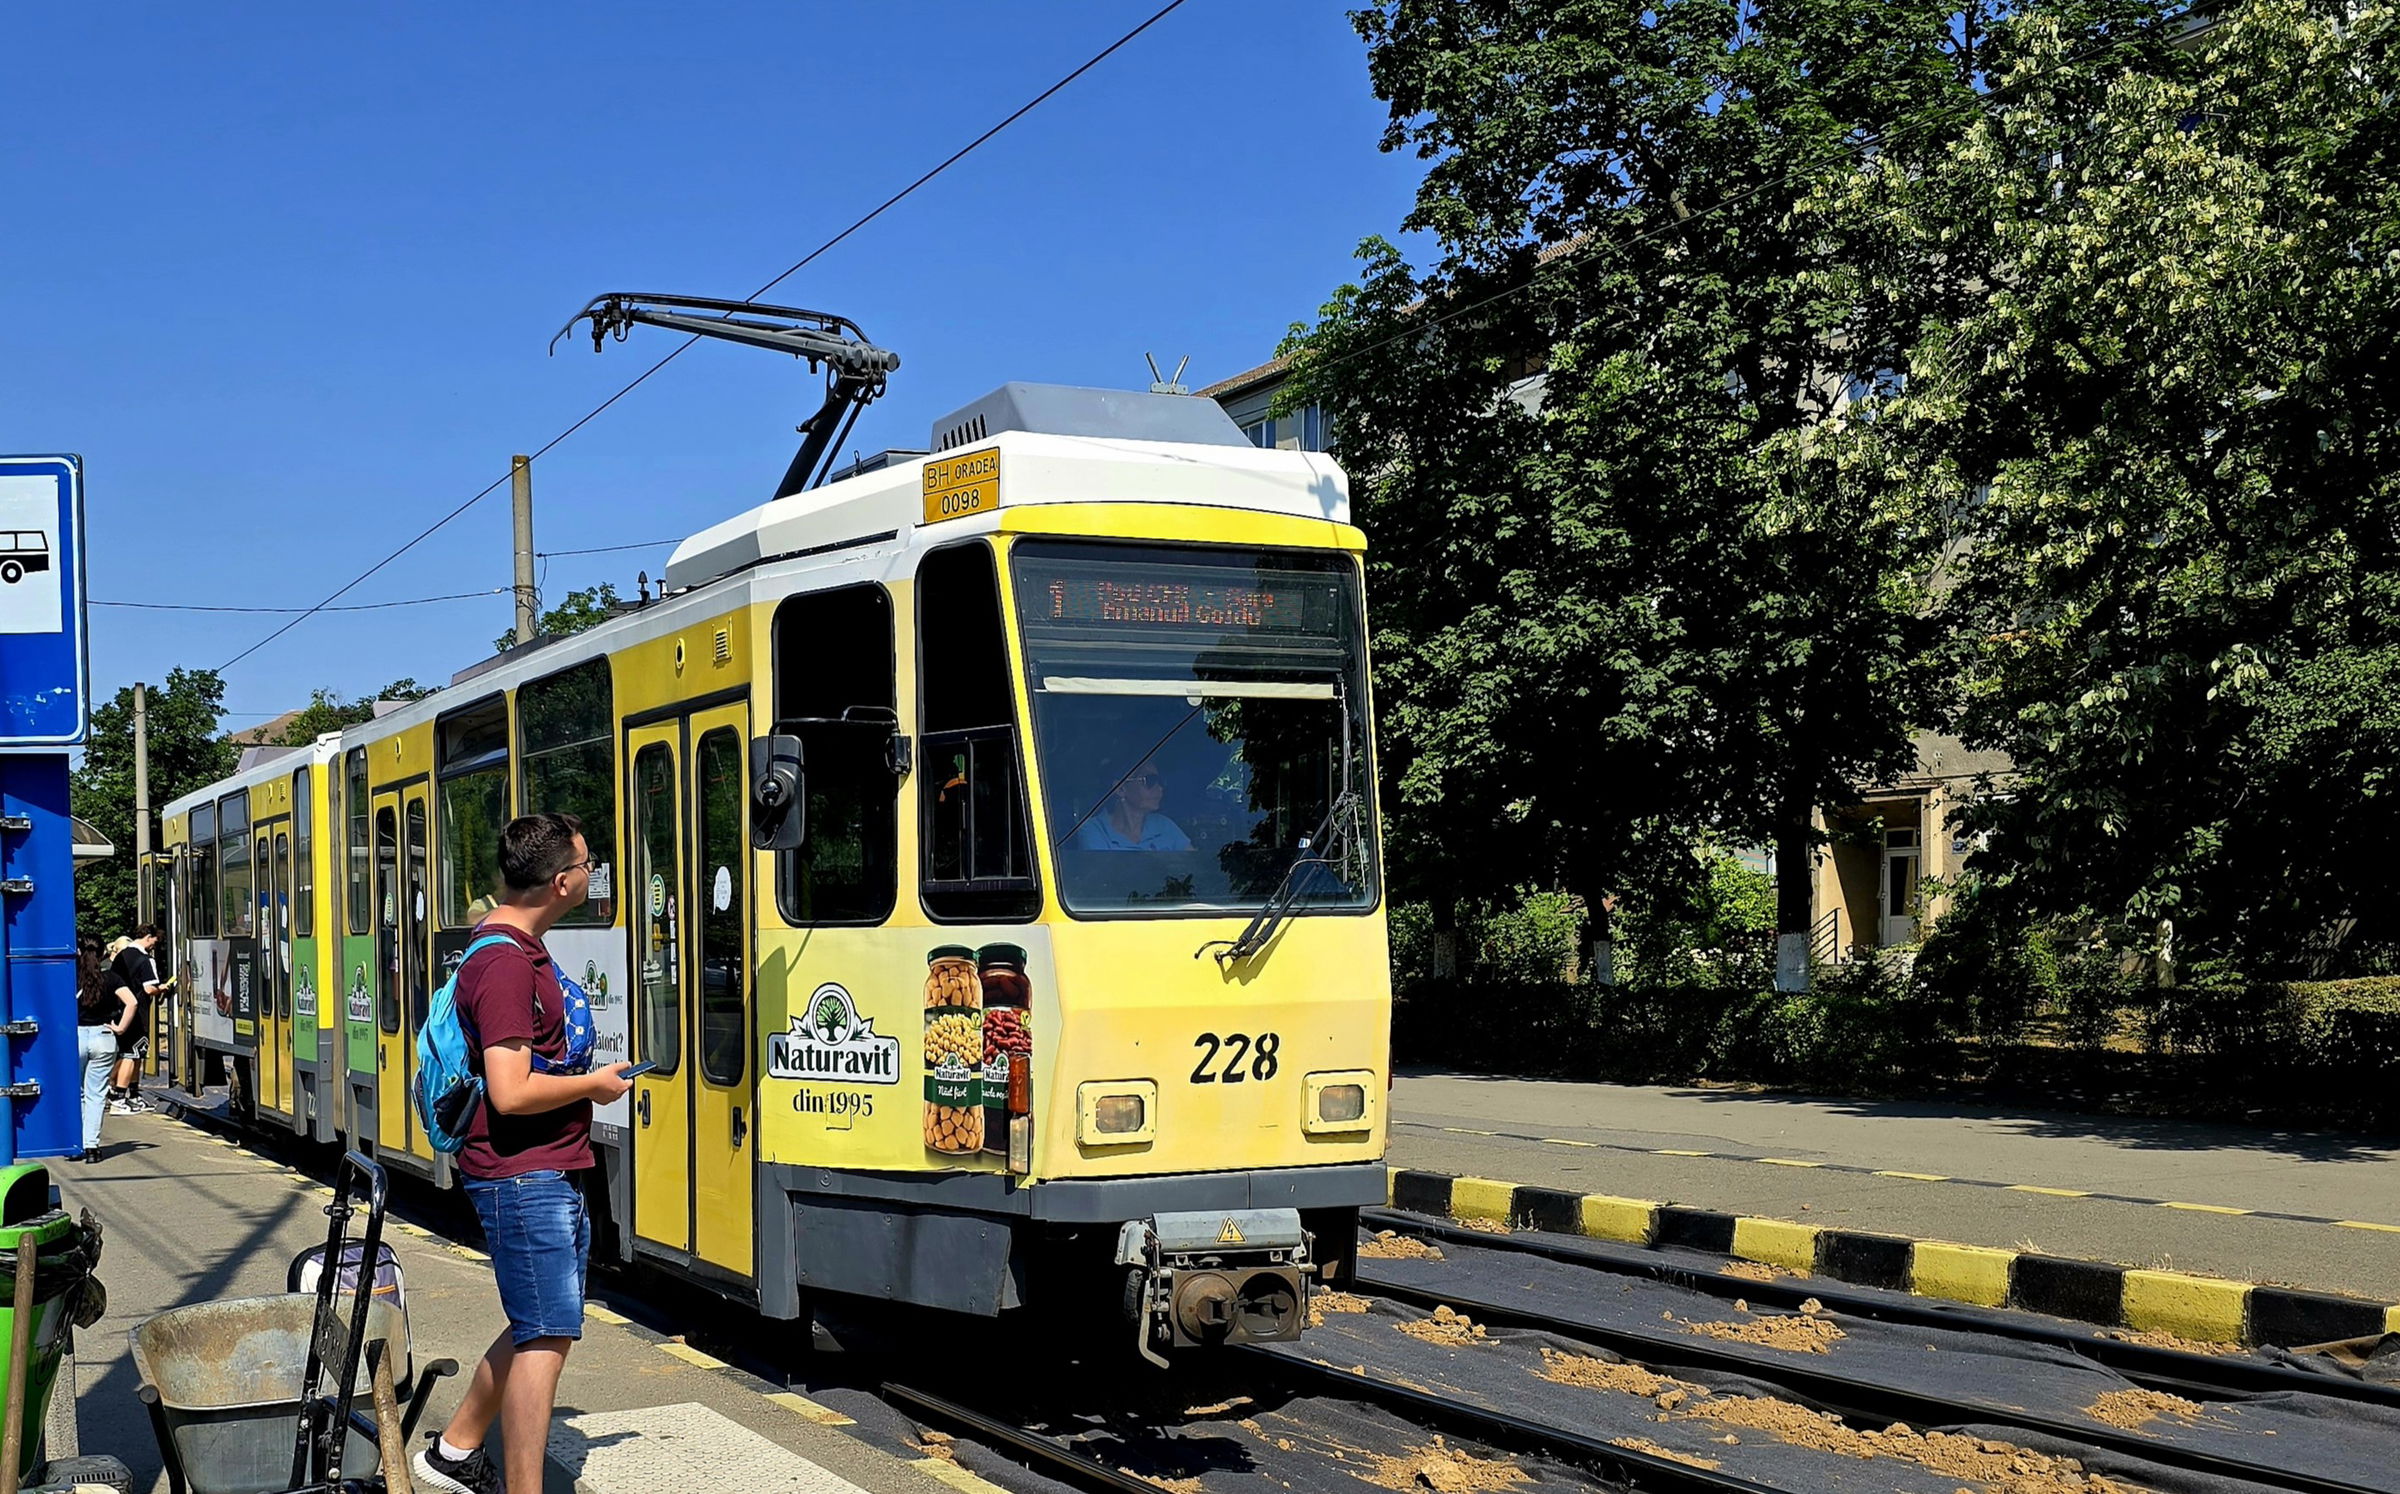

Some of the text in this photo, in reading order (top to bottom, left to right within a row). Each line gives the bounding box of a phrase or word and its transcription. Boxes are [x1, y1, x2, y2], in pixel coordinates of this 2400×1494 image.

[927, 456, 996, 488] BH ORADEA
[941, 488, 980, 515] 0098
[1189, 1032, 1281, 1084] 228
[936, 1068, 969, 1080] Naturavit
[793, 1088, 873, 1117] din 1995
